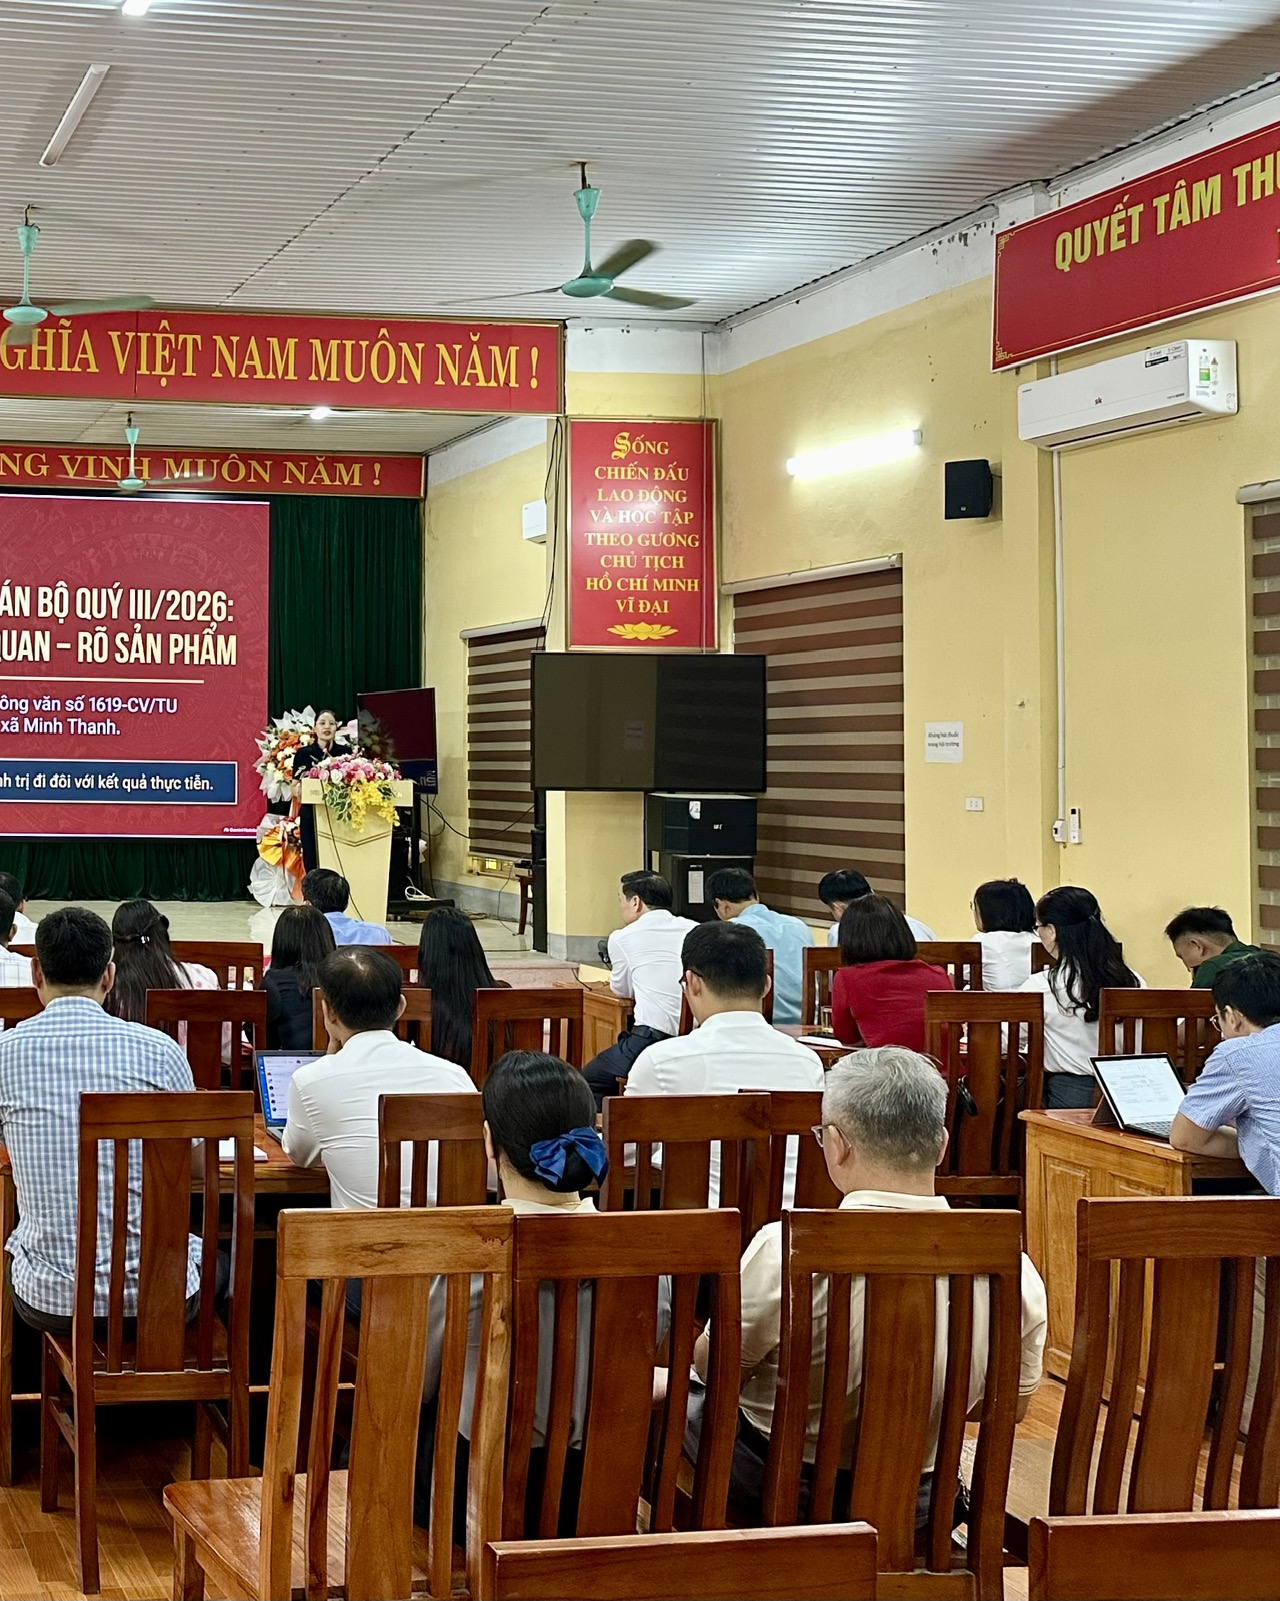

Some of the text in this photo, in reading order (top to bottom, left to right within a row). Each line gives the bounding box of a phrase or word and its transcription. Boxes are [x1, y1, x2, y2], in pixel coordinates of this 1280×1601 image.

[1055, 151, 1280, 272] QUYẾT TÂM TH
[108, 319, 202, 388] VIỆT
[211, 335, 299, 381] NAM
[308, 327, 425, 385] MUÔN
[434, 331, 520, 389] NĂM
[58, 455, 151, 480] VINH
[163, 453, 273, 484] MUÔN
[282, 456, 364, 486] NĂM
[594, 461, 689, 481] CHIẾN ĐẤU
[597, 485, 688, 506] LAO ĐỘNG
[590, 506, 694, 527] VÀ HỌC TẬP
[584, 532, 700, 548] THEO GƯƠNG
[600, 550, 685, 572] CHỦ TỊCH
[585, 571, 700, 592] HỒ CHÍ MINH
[37, 580, 69, 624] BỘ
[75, 582, 124, 621] QUÝ
[129, 589, 234, 622] III/2026:
[615, 596, 670, 617] VĨ ĐẠI
[77, 626, 109, 664] RÕ
[114, 623, 162, 664] SẢN
[169, 621, 237, 666] PHẨM
[33, 696, 61, 712] văn
[65, 694, 86, 712] số
[89, 697, 178, 714] 1619-CV/TU
[0, 716, 20, 733] xã
[23, 717, 63, 735] Minh
[67, 718, 121, 735] Thanh.
[15, 774, 30, 791] trị
[33, 773, 46, 788] đi
[49, 773, 71, 789] đôi
[74, 773, 95, 789] với
[98, 773, 120, 789] kết
[122, 773, 148, 792] quả
[150, 776, 181, 792] thực
[184, 774, 214, 791] tiễn.
